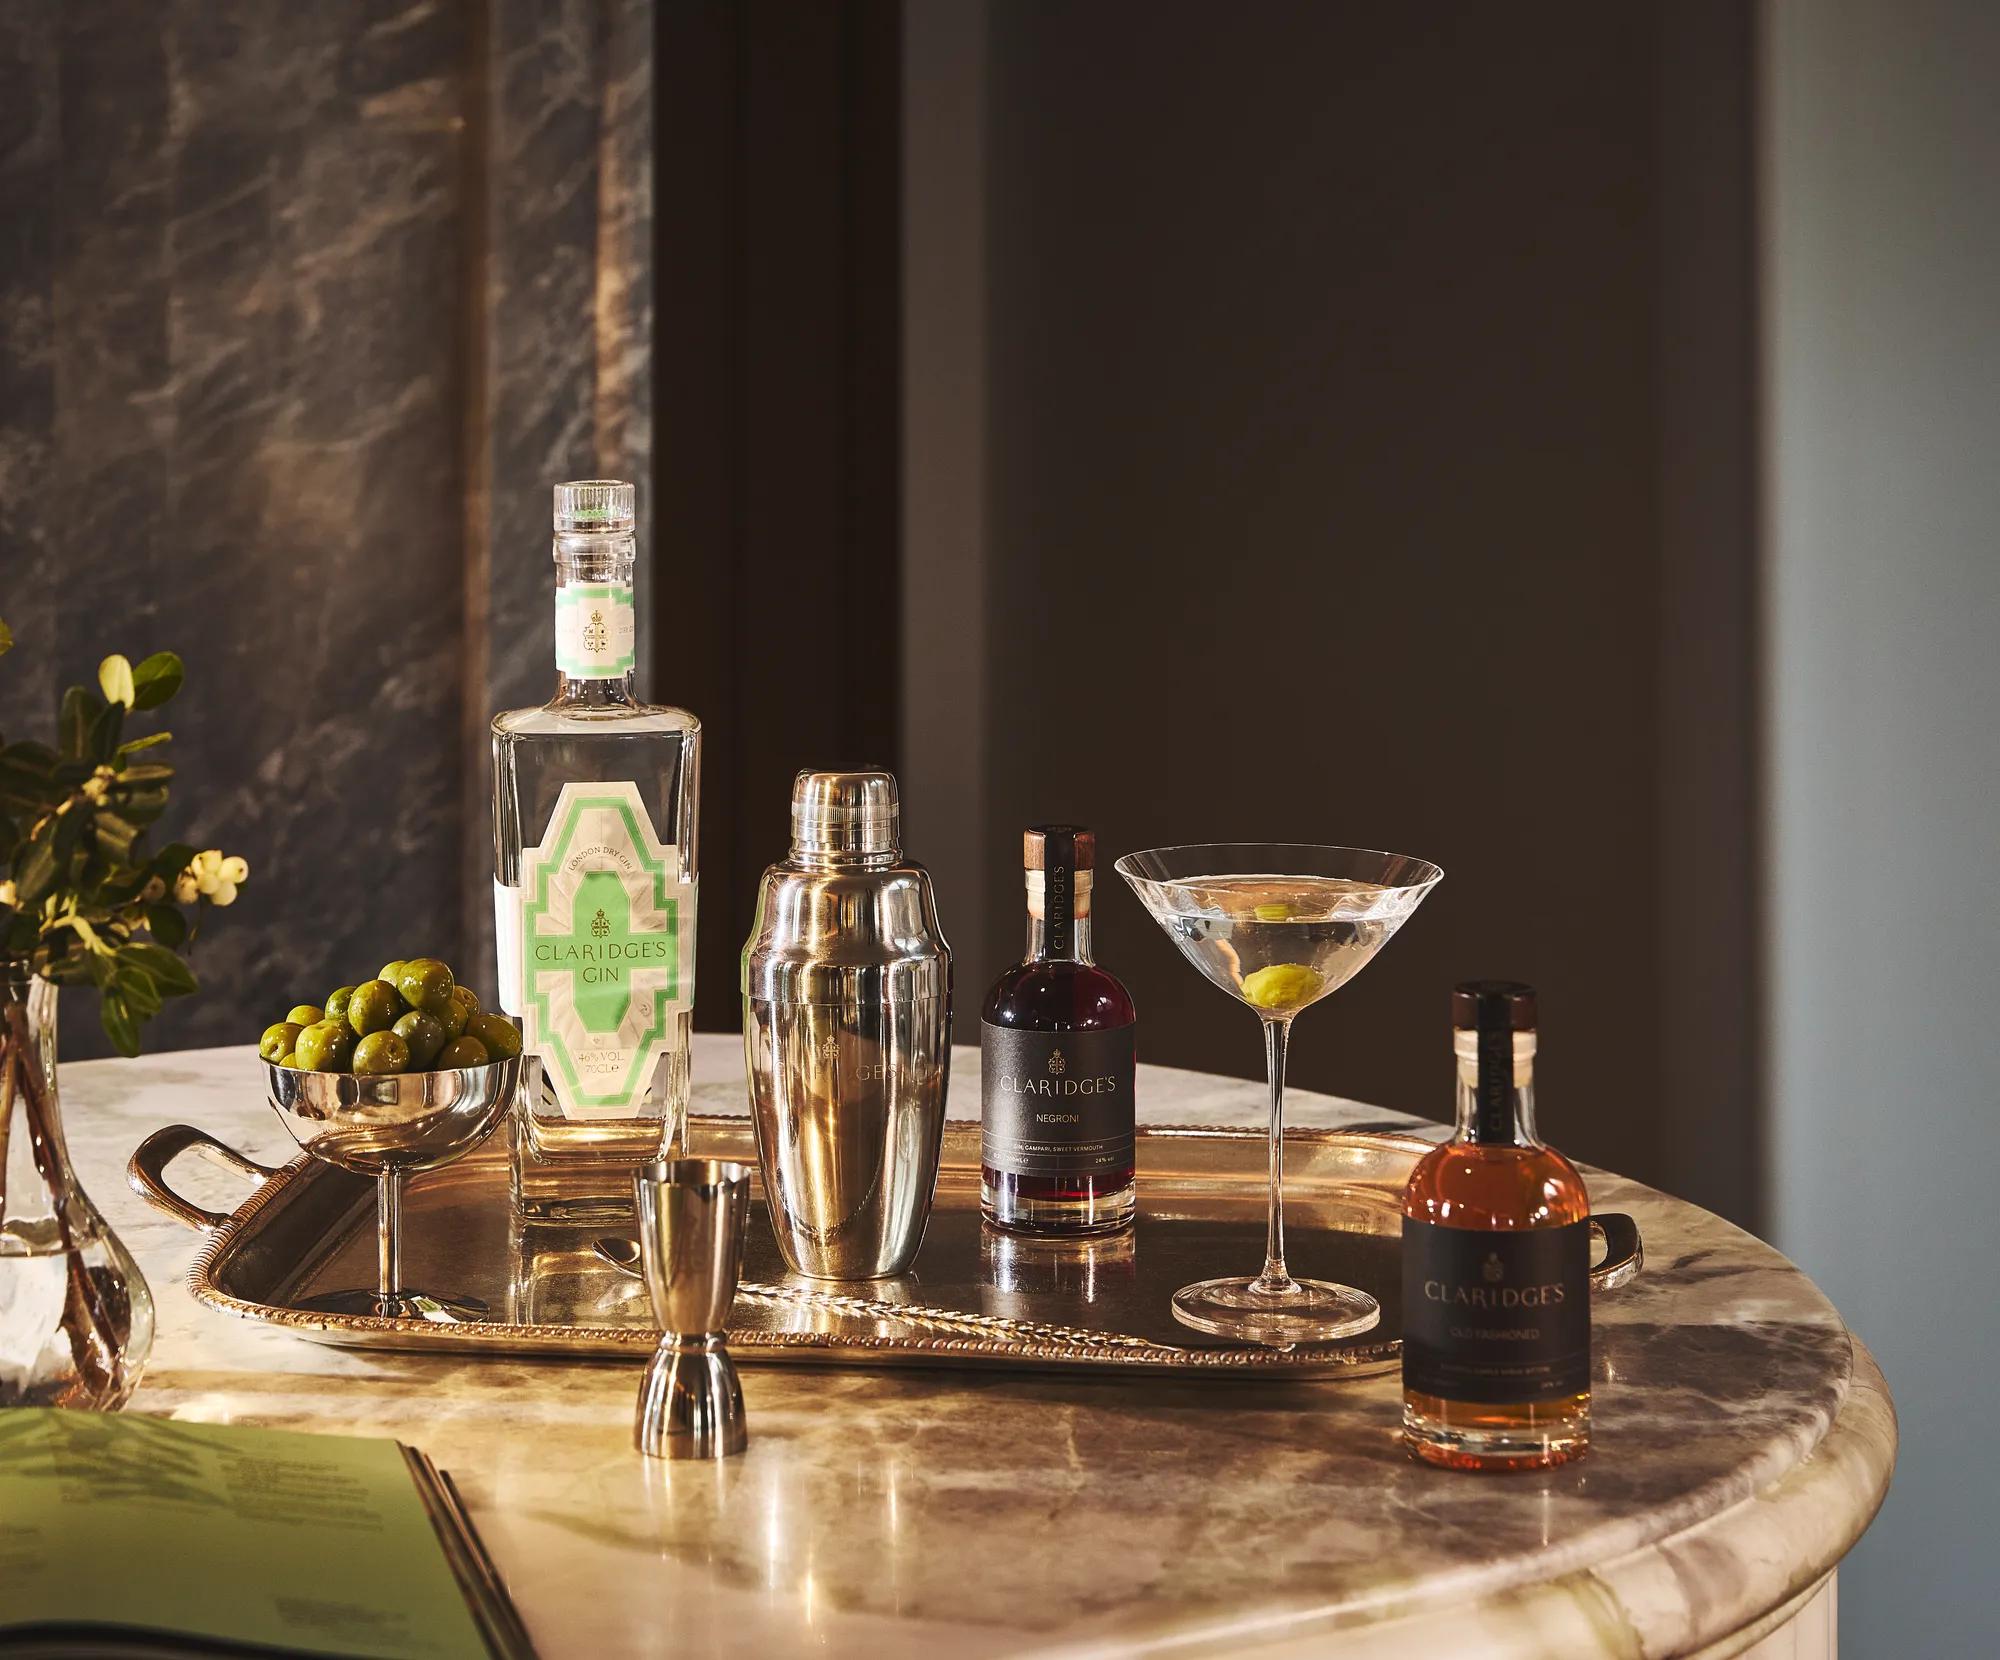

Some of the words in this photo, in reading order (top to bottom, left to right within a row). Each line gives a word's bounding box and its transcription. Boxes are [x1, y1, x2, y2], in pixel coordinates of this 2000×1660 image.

[568, 846, 600, 871] LONDON
[603, 846, 620, 857] DRY
[619, 855, 633, 870] GIN
[535, 941, 666, 962] CLARIDGE'S
[582, 967, 619, 983] GIN
[600, 1051, 625, 1062] VOL
[1000, 1075, 1116, 1097] CLARIDGE'S
[1036, 1113, 1079, 1123] NEGRONI
[1424, 1280, 1565, 1309] CLARIDGE'S
